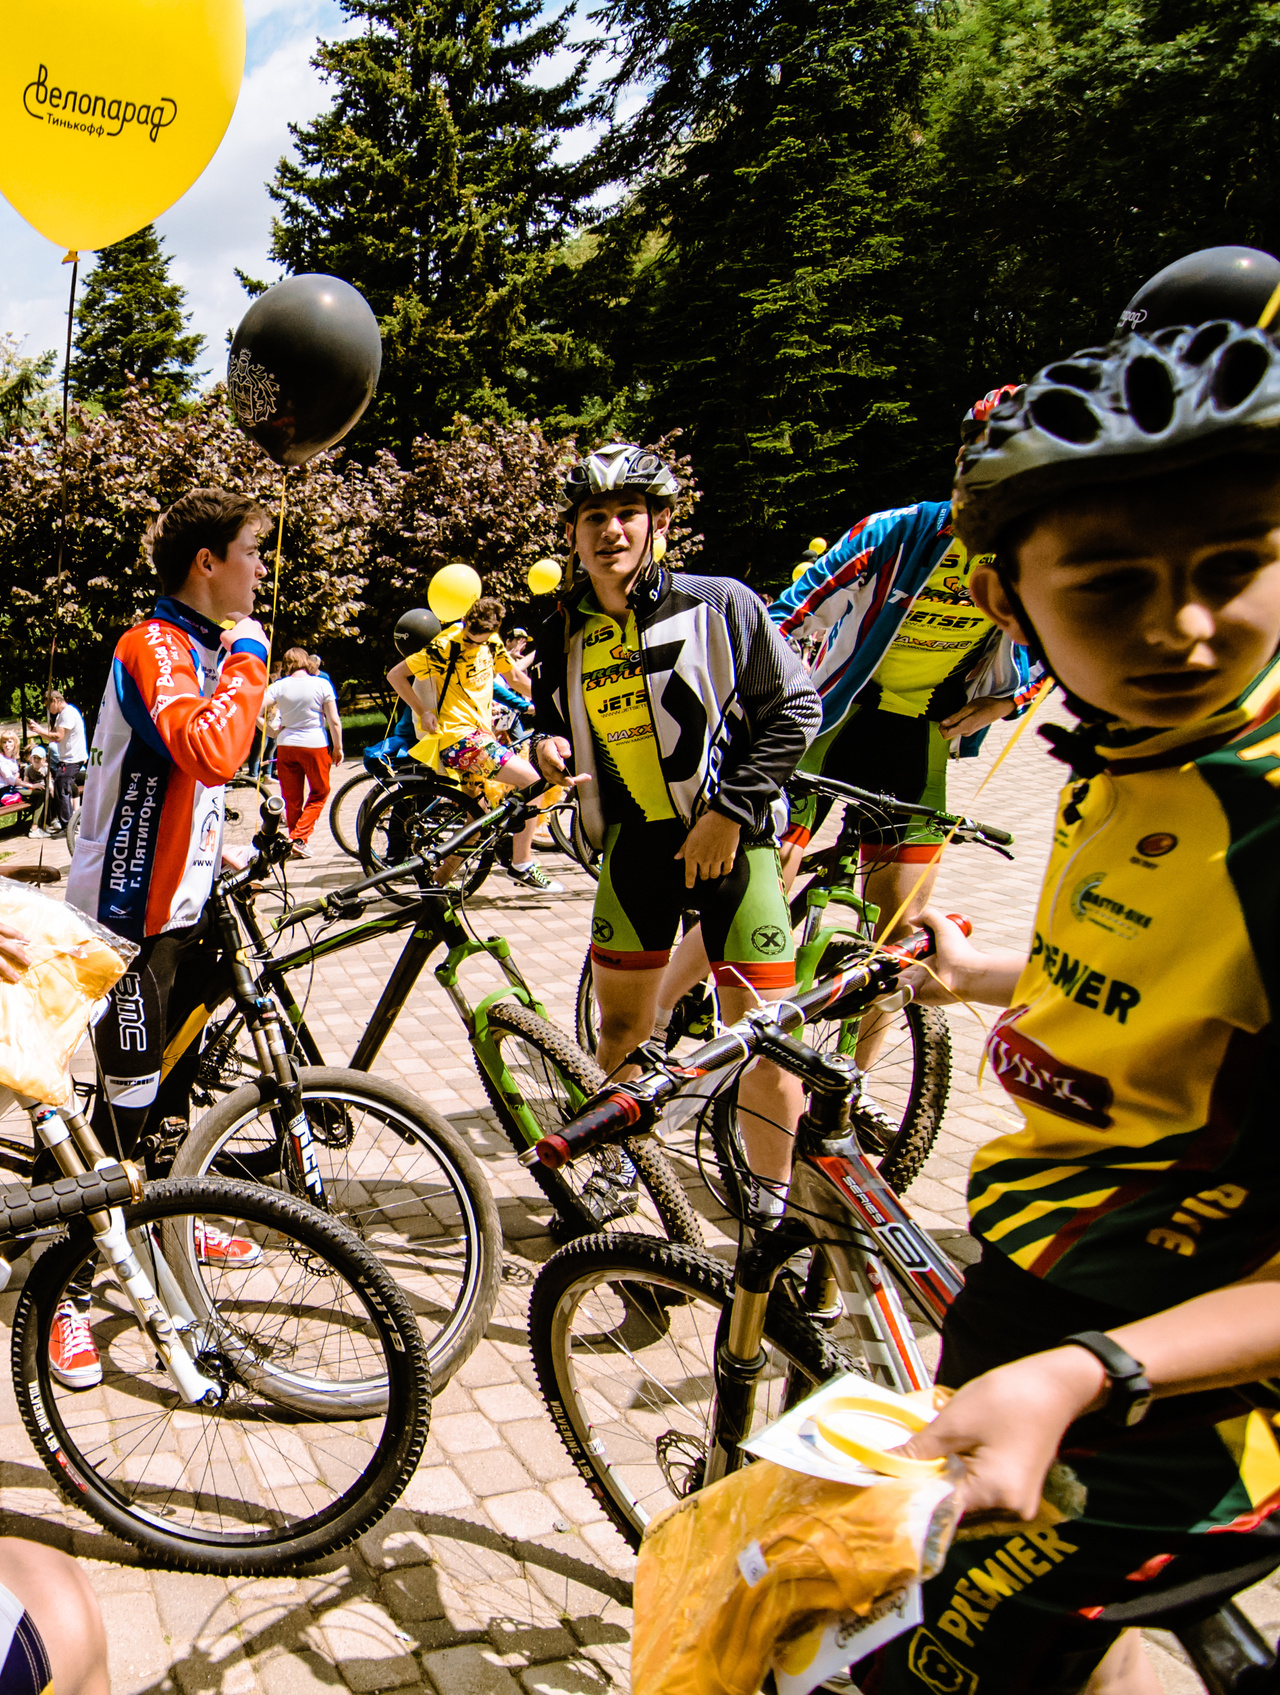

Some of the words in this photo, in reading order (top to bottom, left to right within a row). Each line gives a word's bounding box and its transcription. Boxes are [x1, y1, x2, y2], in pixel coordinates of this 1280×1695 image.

[23, 63, 178, 143] Велопарад
[46, 112, 106, 138] Тинькофф
[597, 689, 649, 715] JETS
[607, 723, 654, 743] MAXX
[109, 805, 135, 893] ДЮСШОР
[130, 775, 159, 871] Пятигорск
[762, 1040, 812, 1072] RITCHEY
[841, 1174, 887, 1226] SERIES
[937, 1522, 1080, 1648] PREMIER
